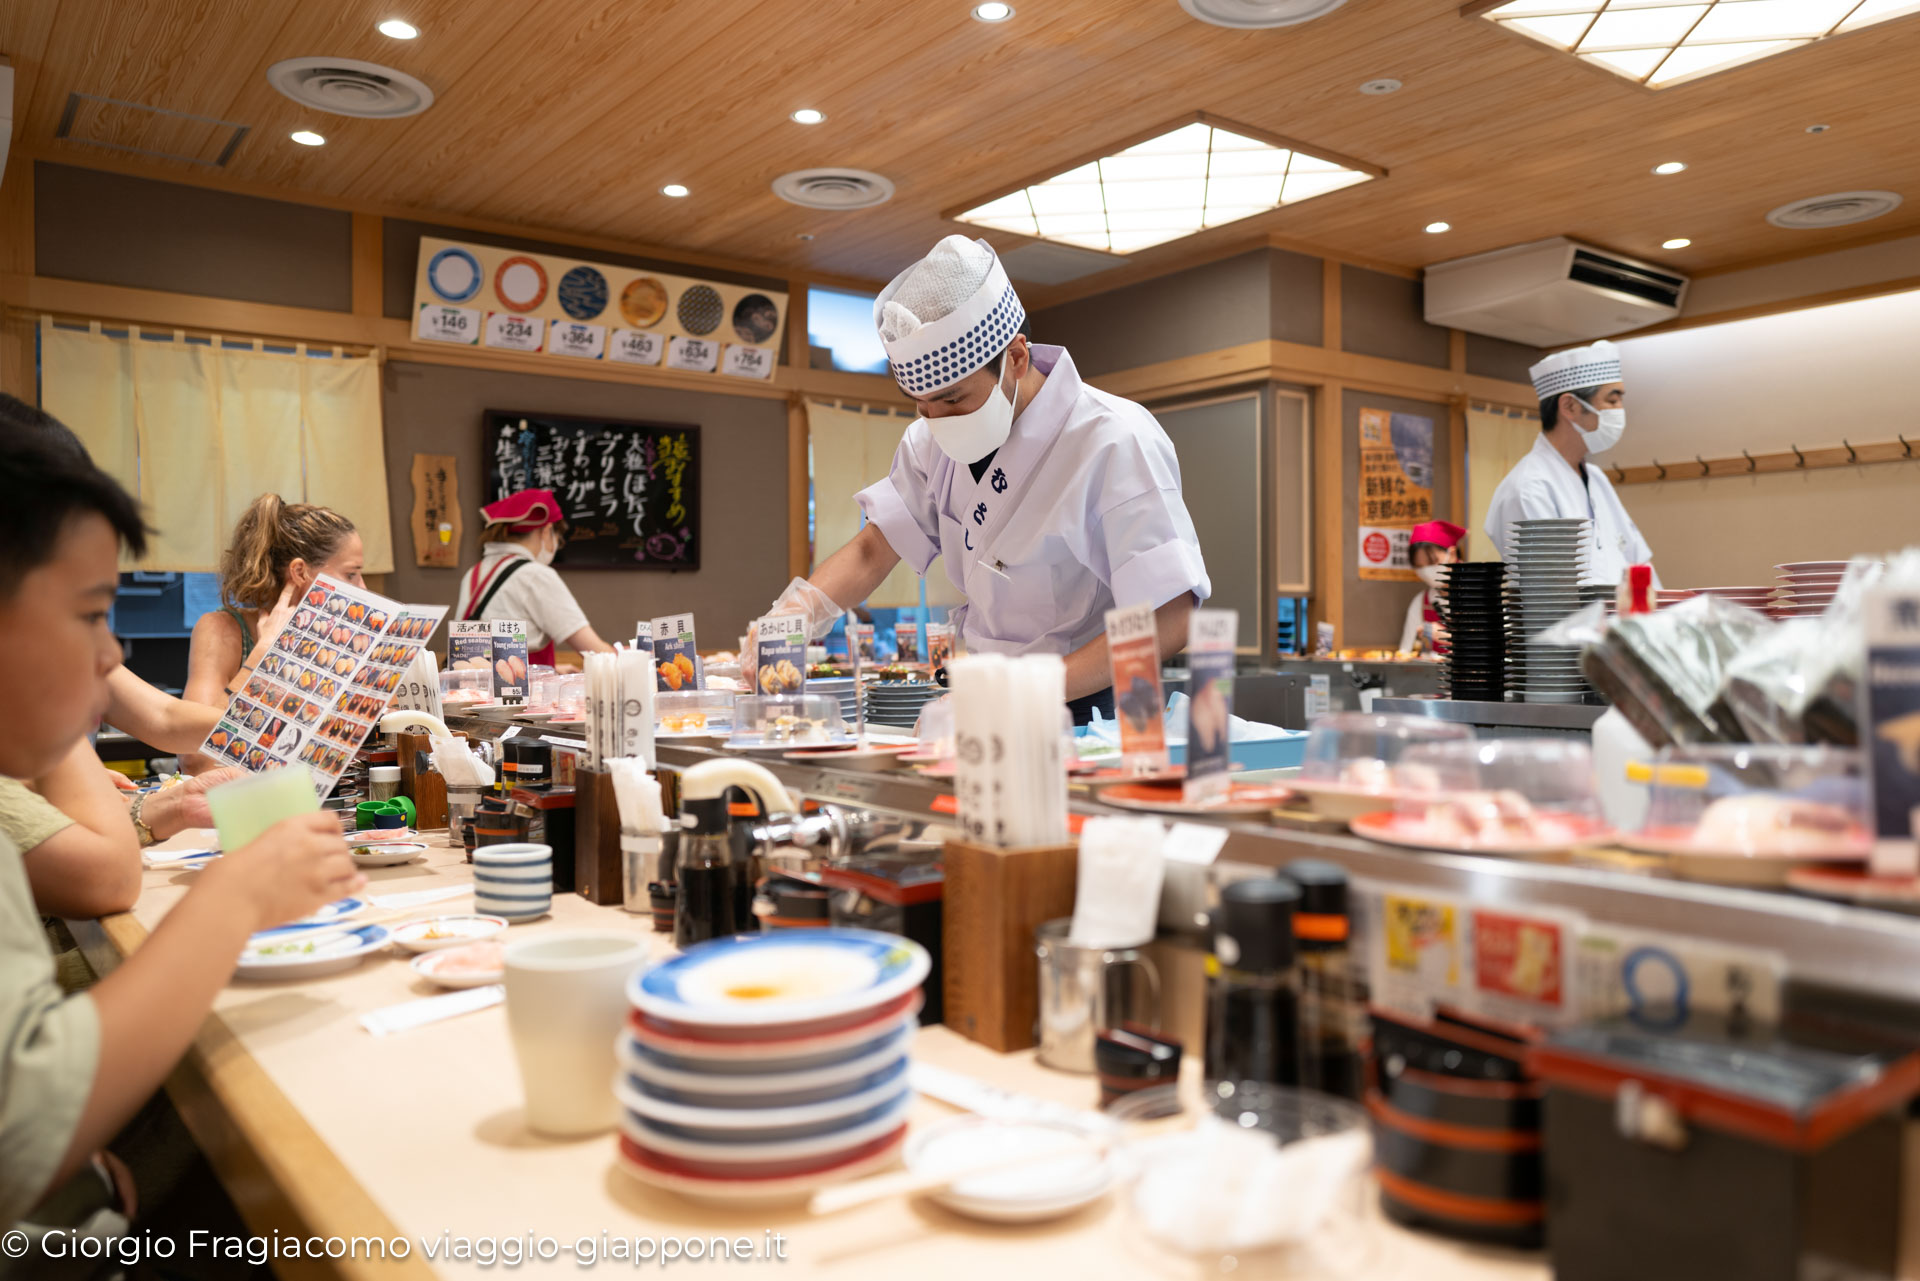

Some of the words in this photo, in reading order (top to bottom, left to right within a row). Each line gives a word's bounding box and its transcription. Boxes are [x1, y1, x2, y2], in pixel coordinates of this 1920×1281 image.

[432, 315, 468, 330] ¥146
[498, 323, 533, 338] ¥234
[499, 622, 520, 633] はまち
[759, 619, 803, 636] あかにし貝
